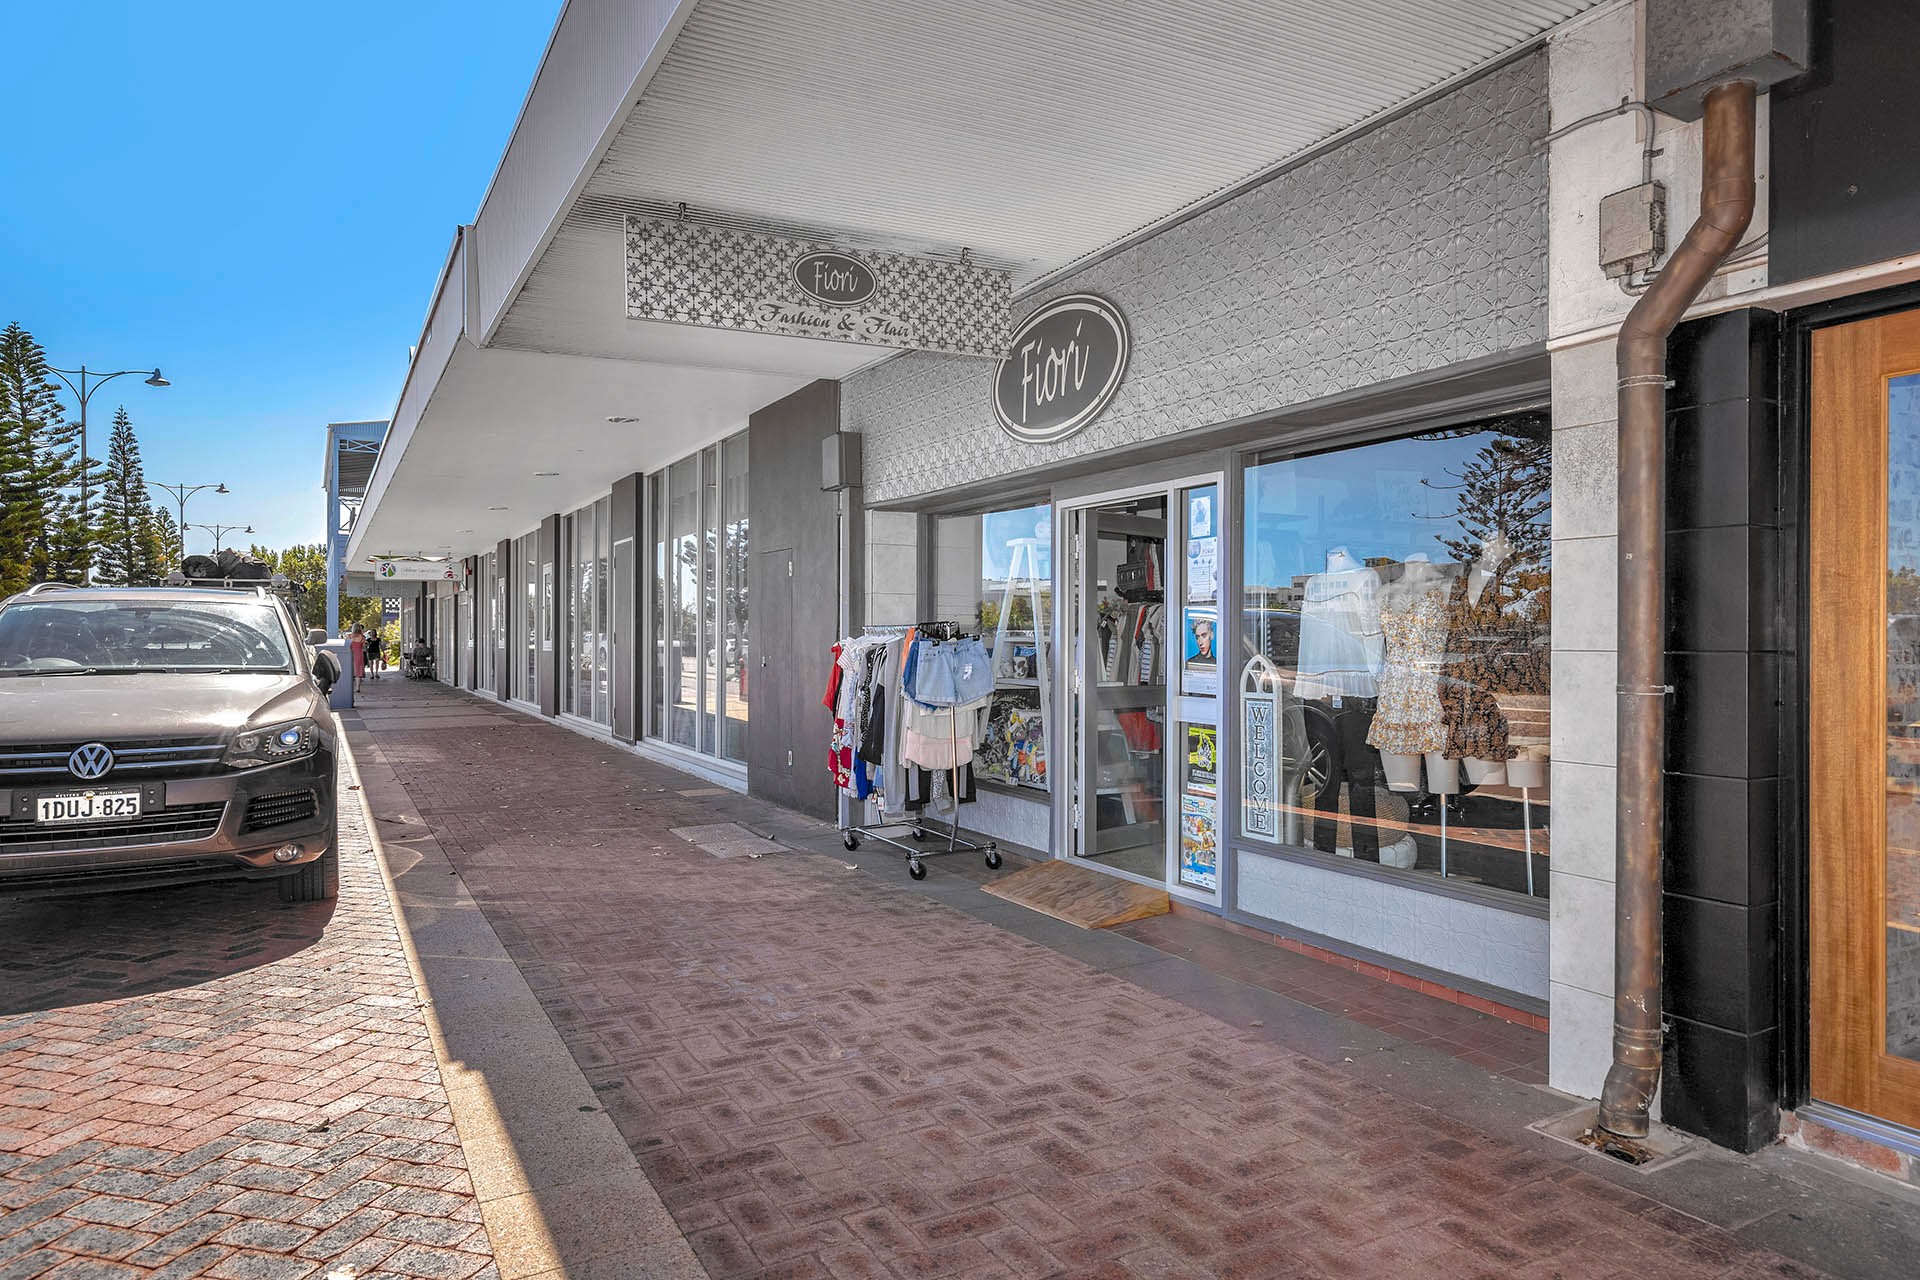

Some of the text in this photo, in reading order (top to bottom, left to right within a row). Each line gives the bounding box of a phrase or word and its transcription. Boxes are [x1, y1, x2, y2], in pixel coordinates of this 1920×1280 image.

[814, 261, 859, 294] Fiori
[758, 303, 910, 338] Fashion & Flair
[1020, 317, 1090, 424] Fiori
[1250, 706, 1269, 830] WELCOME
